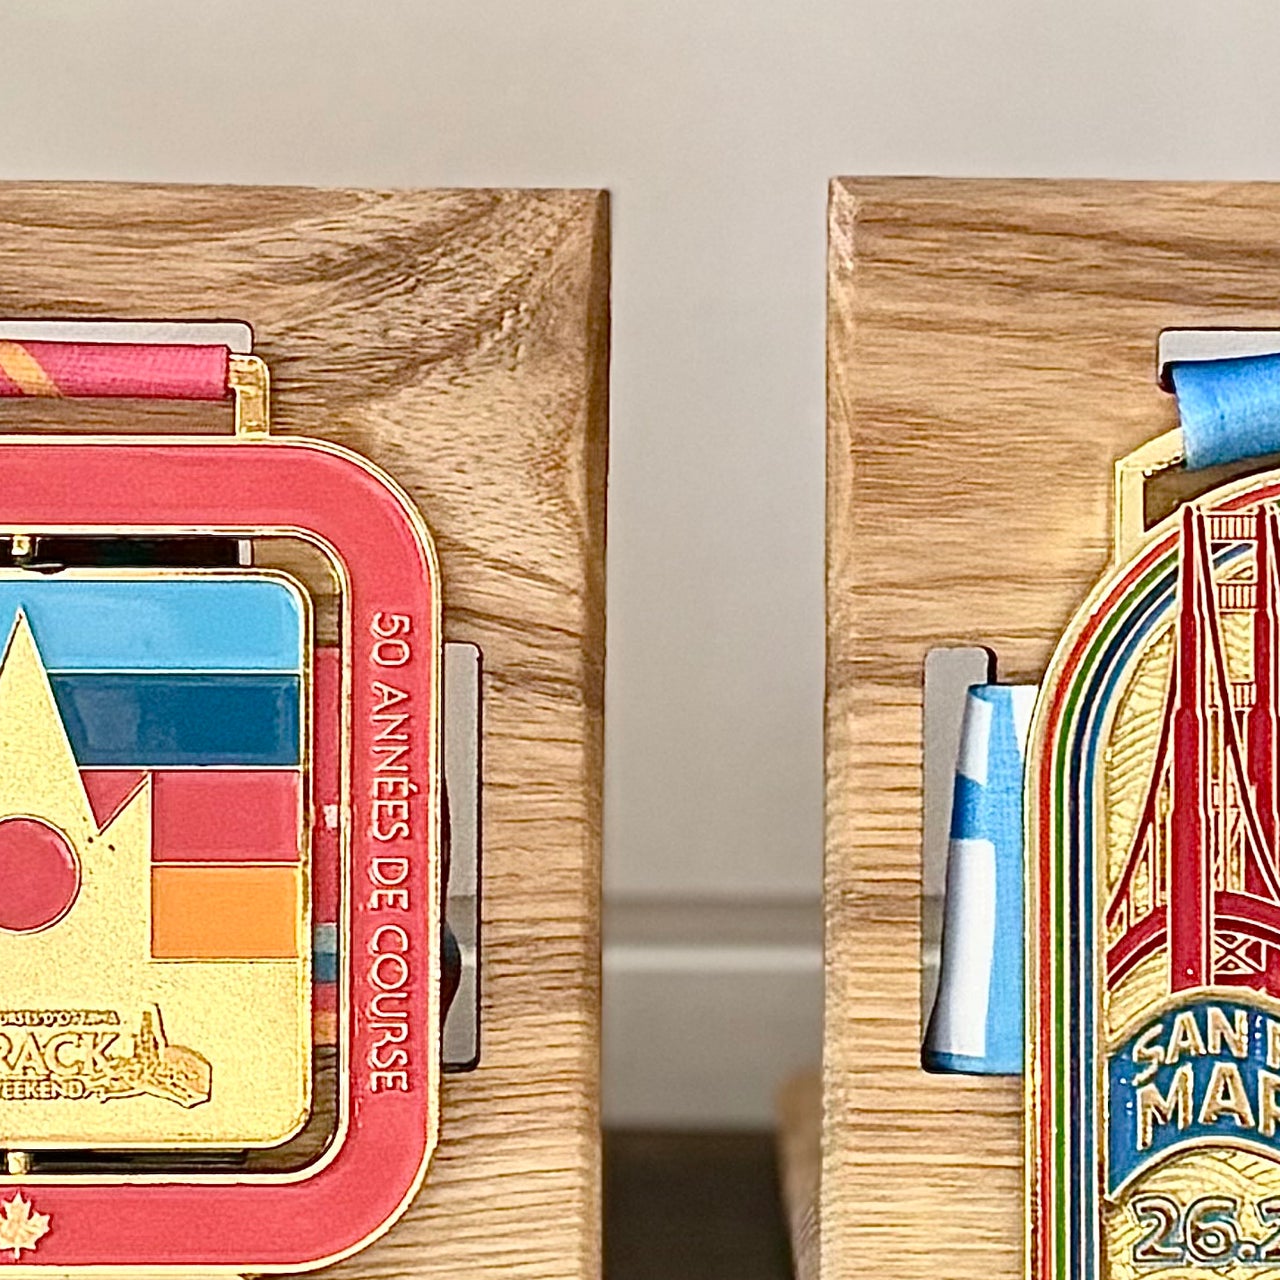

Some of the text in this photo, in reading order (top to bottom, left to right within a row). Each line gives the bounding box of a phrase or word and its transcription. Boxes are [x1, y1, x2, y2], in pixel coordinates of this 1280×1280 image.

[368, 611, 418, 1093] 50 ANNÉES DE COURSE
[1131, 1006, 1249, 1087] SAN
